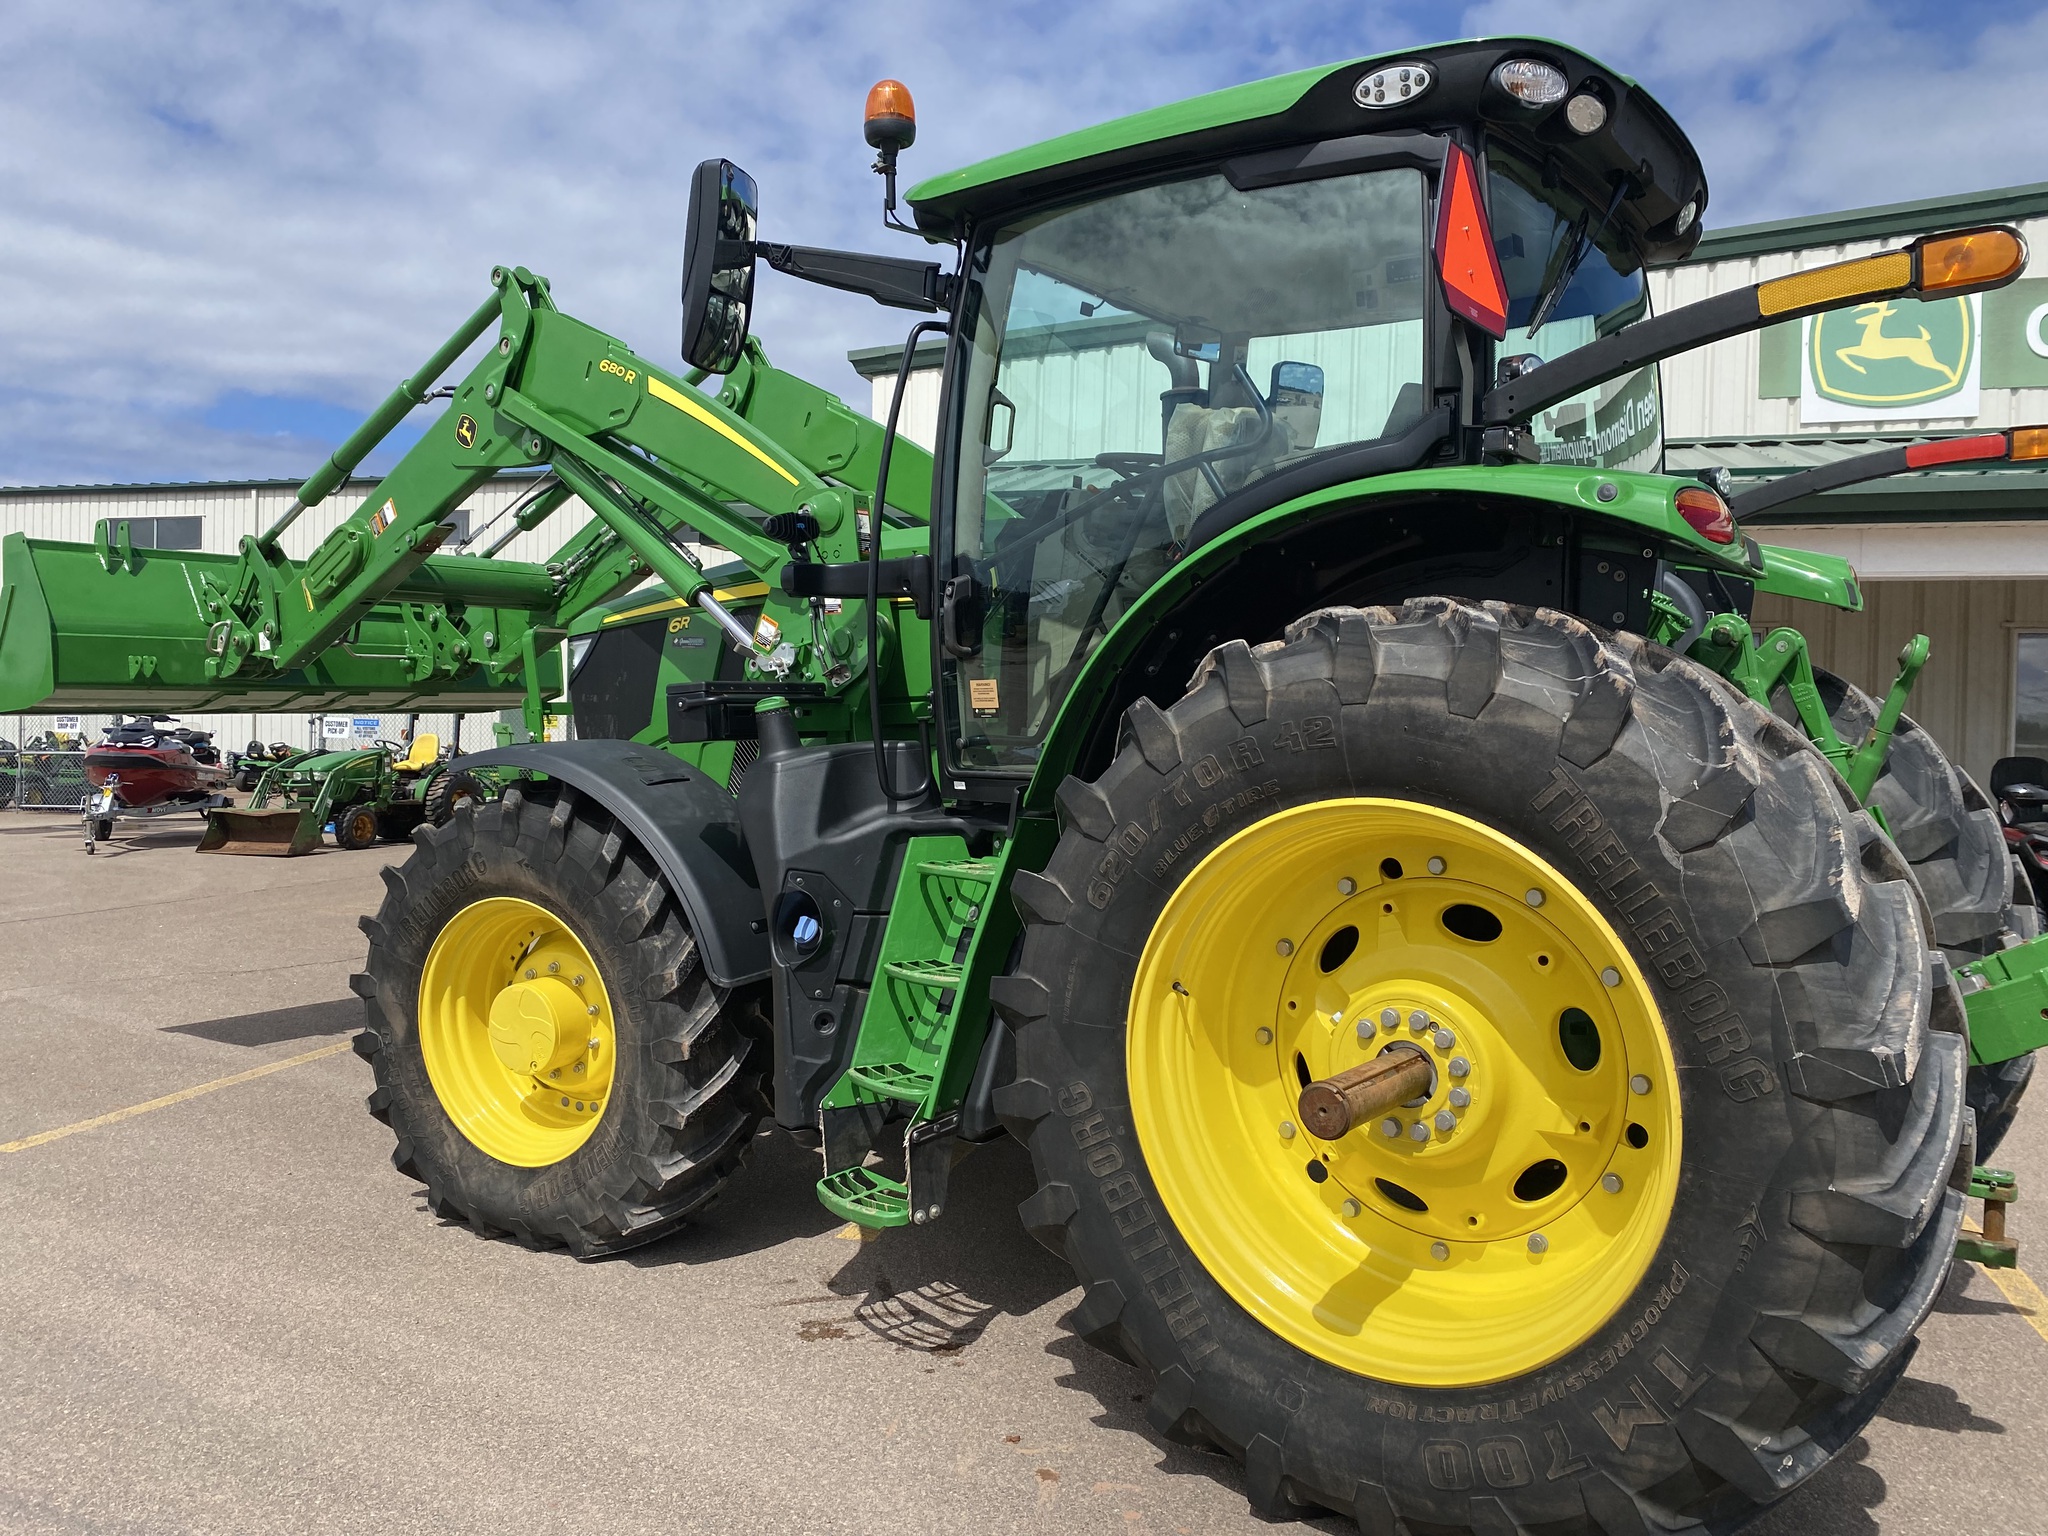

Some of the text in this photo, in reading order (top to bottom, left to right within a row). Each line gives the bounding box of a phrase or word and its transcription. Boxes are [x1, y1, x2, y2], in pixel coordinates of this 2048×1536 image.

[668, 615, 691, 634] 6R
[1272, 715, 1337, 752] 42
[1152, 778, 1281, 878] BLUE TIRE
[394, 852, 487, 948] TRELLEBORG
[1529, 763, 1775, 1103] TRELLEBORG
[516, 1125, 635, 1216] TRELLEBORG
[1057, 1080, 1221, 1373] TRELLEBORG
